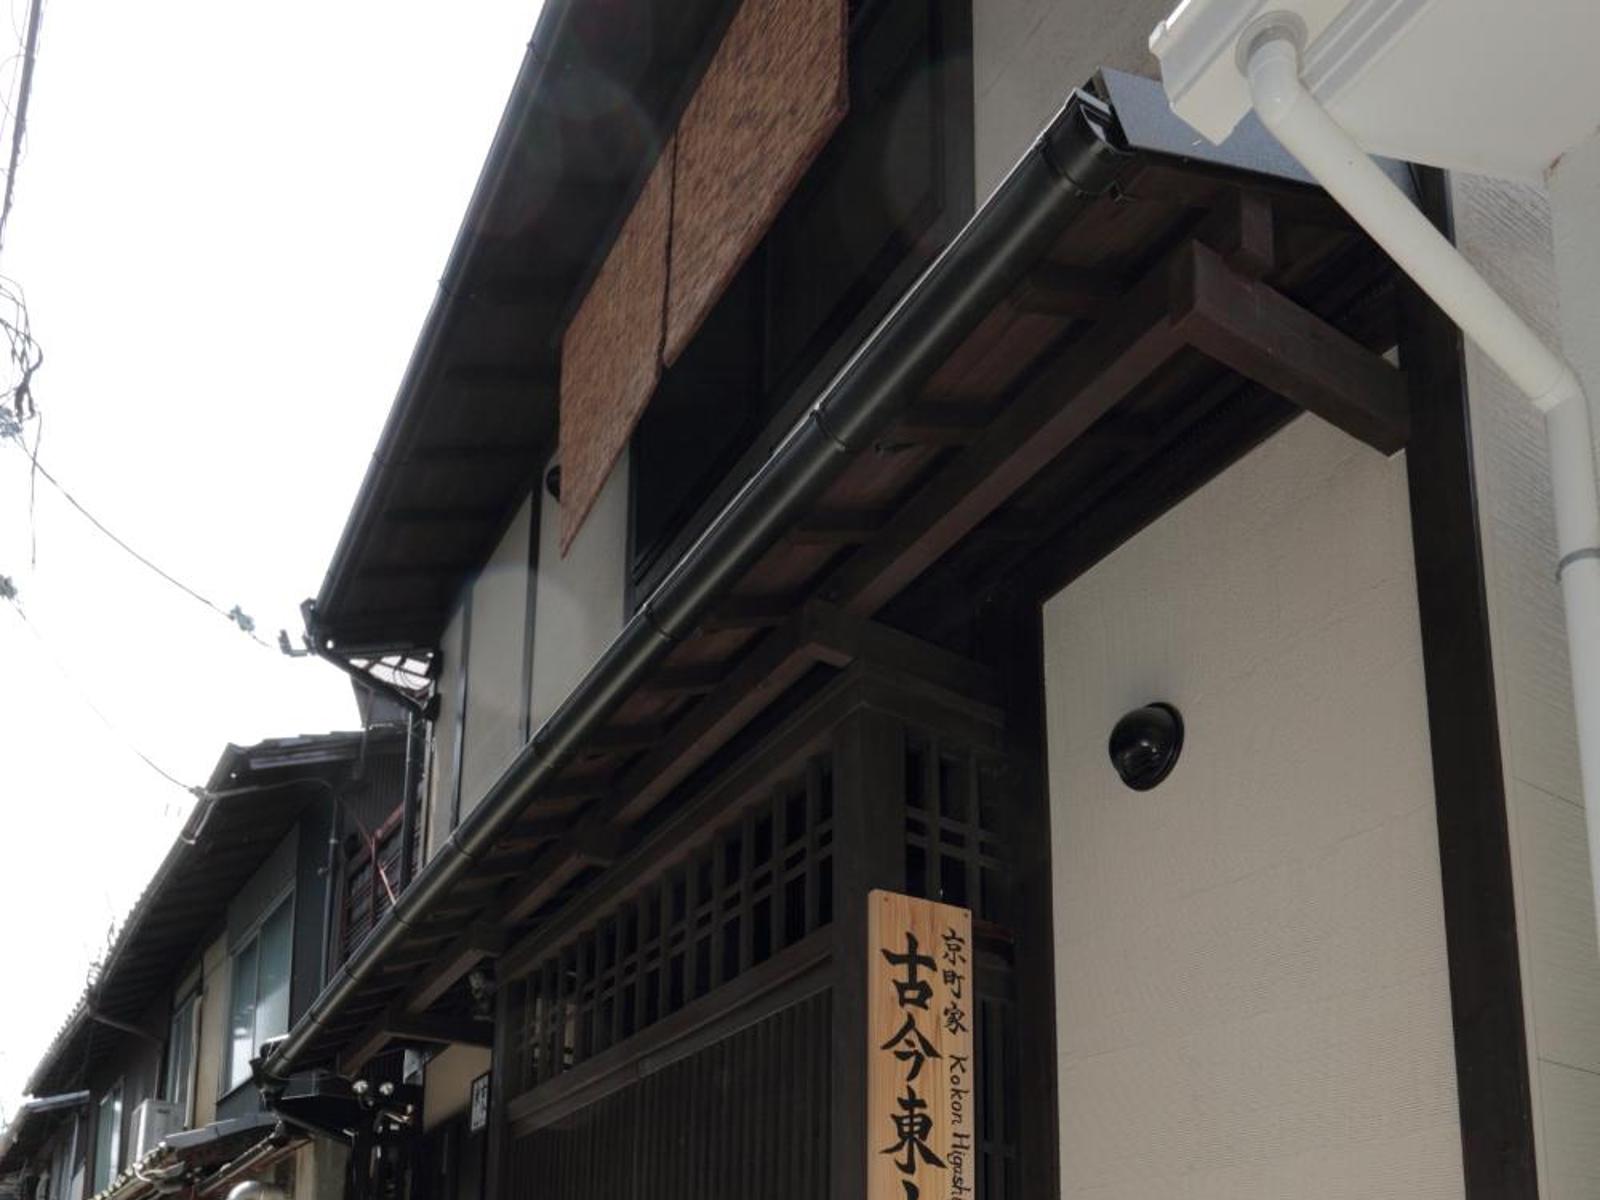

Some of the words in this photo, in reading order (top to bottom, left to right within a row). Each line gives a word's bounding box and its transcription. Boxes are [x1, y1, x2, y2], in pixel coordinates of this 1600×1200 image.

[941, 927, 968, 1035] 京町家
[949, 1054, 970, 1126] Kokon
